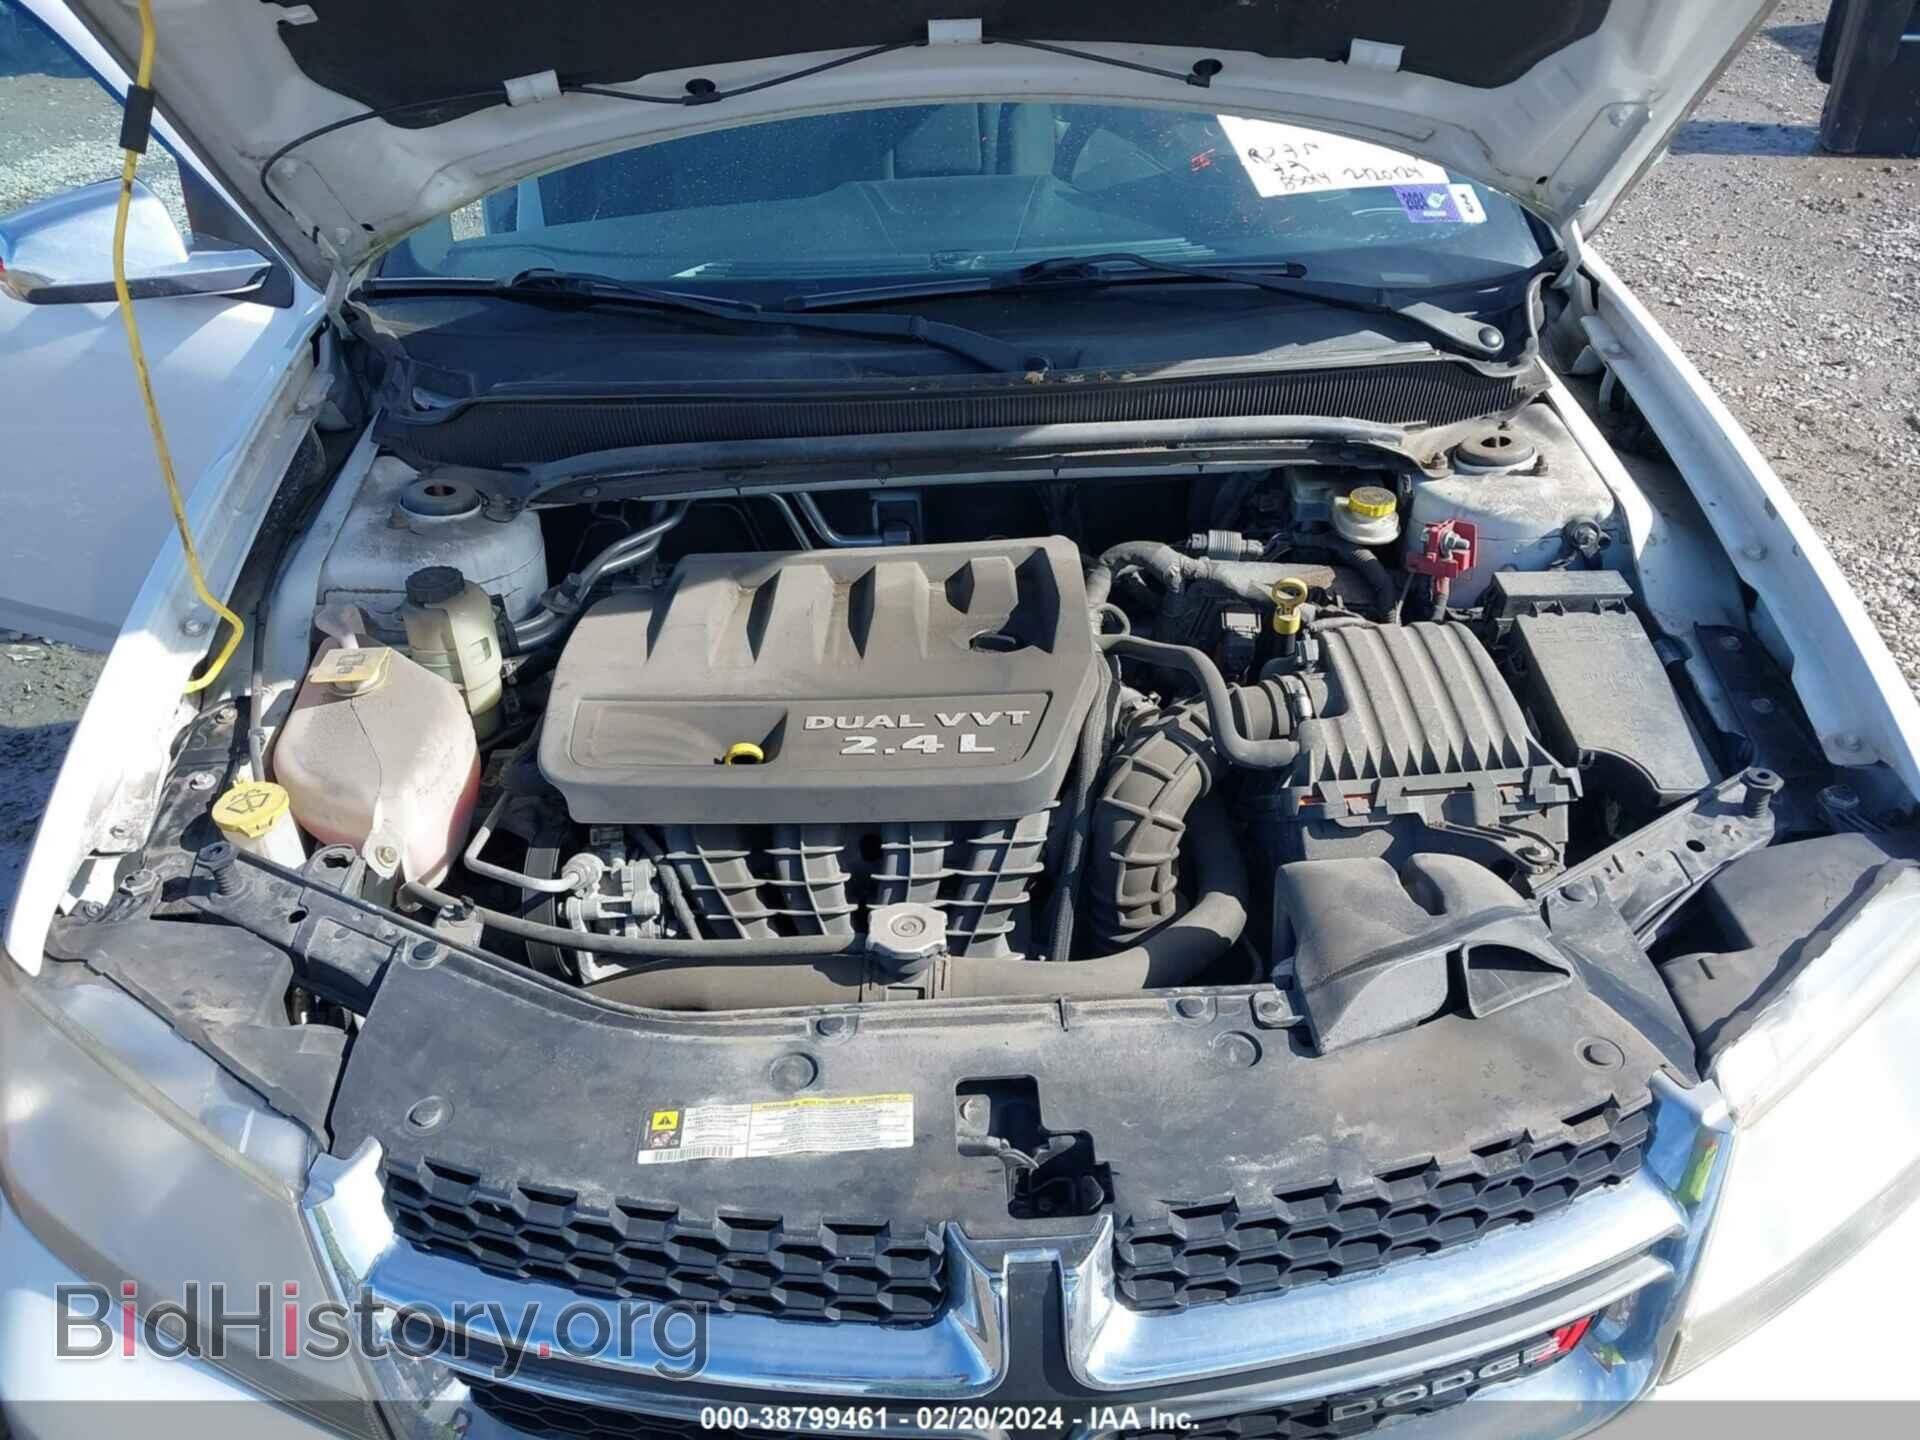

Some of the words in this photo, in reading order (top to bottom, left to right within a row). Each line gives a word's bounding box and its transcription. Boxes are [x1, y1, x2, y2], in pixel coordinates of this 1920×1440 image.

[802, 713, 926, 730] DUAL
[937, 710, 1032, 728] VVT
[1331, 1336, 1561, 1422] DODGE
